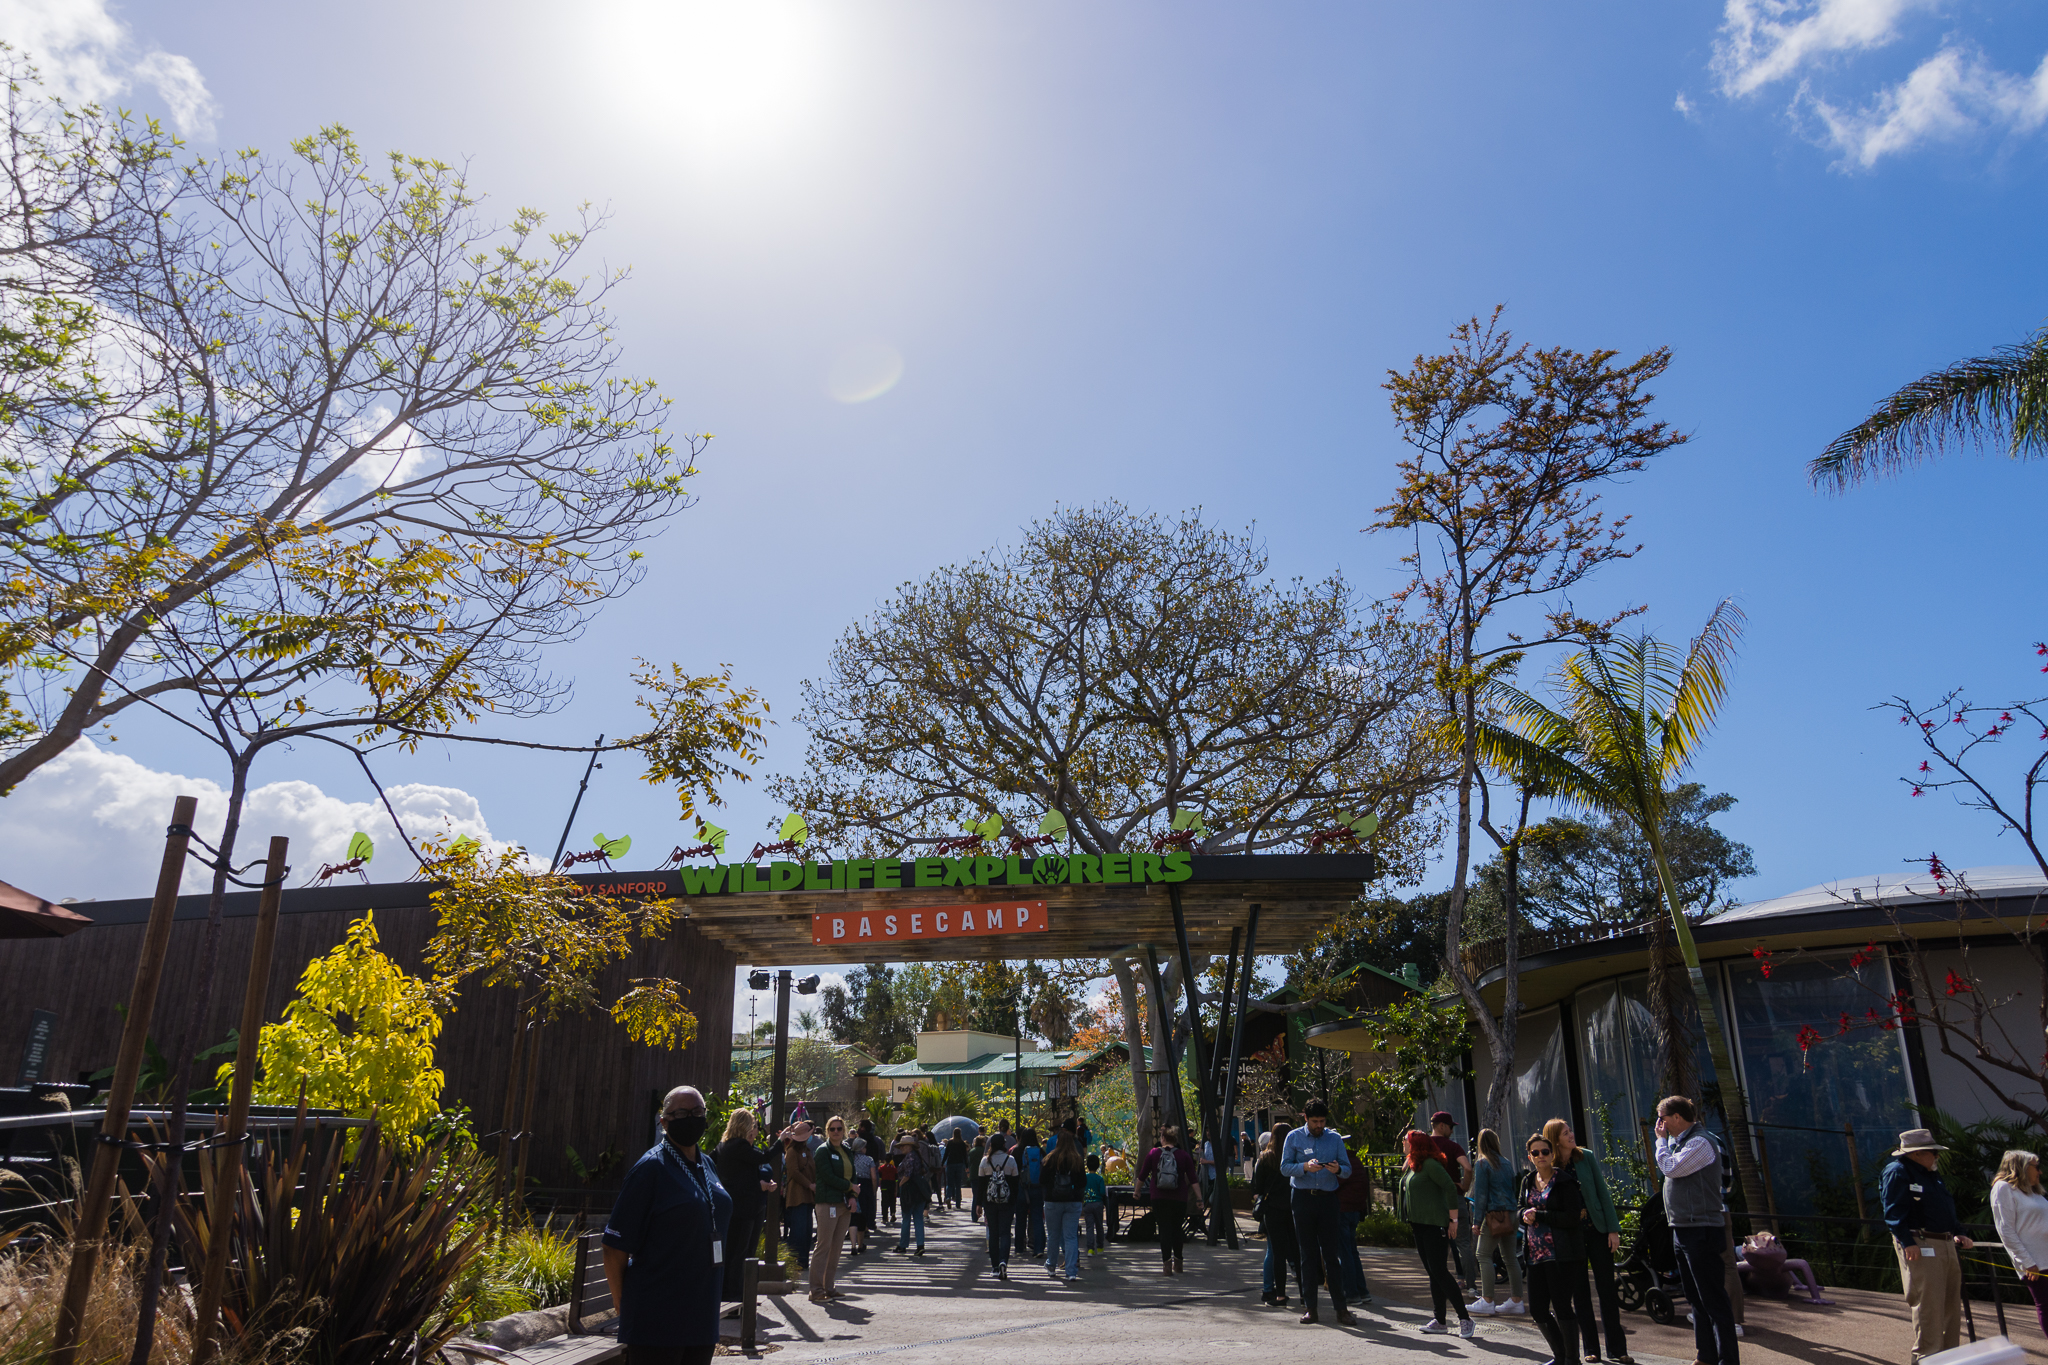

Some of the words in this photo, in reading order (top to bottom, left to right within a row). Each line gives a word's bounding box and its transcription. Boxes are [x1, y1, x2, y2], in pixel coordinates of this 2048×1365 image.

[598, 881, 667, 895] SANFORD
[679, 857, 902, 894] WILDLIFE
[914, 851, 1193, 887] EXPLORERS
[832, 907, 1030, 939] BASECAMP
